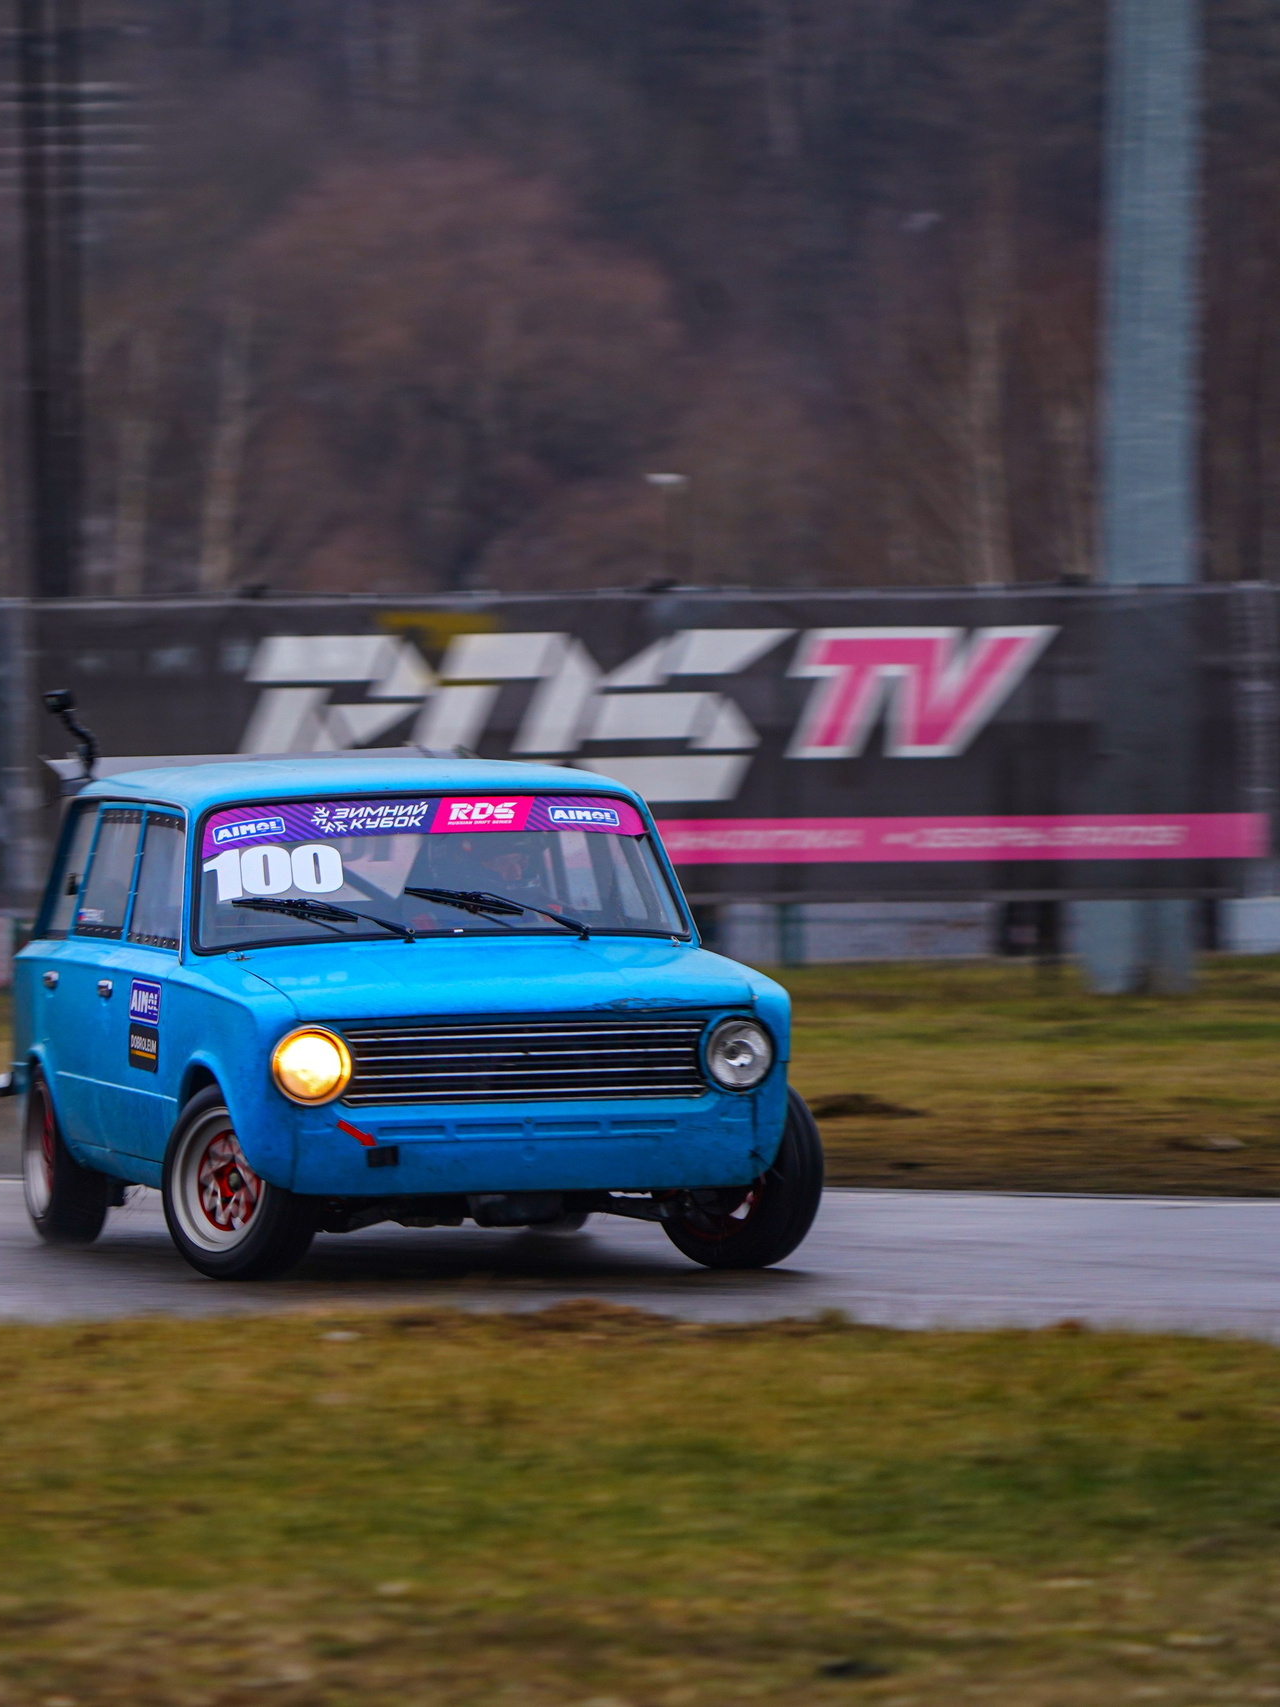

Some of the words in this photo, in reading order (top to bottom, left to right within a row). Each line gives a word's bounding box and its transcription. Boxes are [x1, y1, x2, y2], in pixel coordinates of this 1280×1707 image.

[782, 625, 1064, 759] TV
[332, 801, 429, 819] ЗИМНИЙ
[449, 802, 518, 820] RDS
[553, 809, 617, 823] AIMOL
[217, 819, 282, 841] AIMOL
[349, 815, 425, 831] КУБОК
[203, 844, 344, 901] 100
